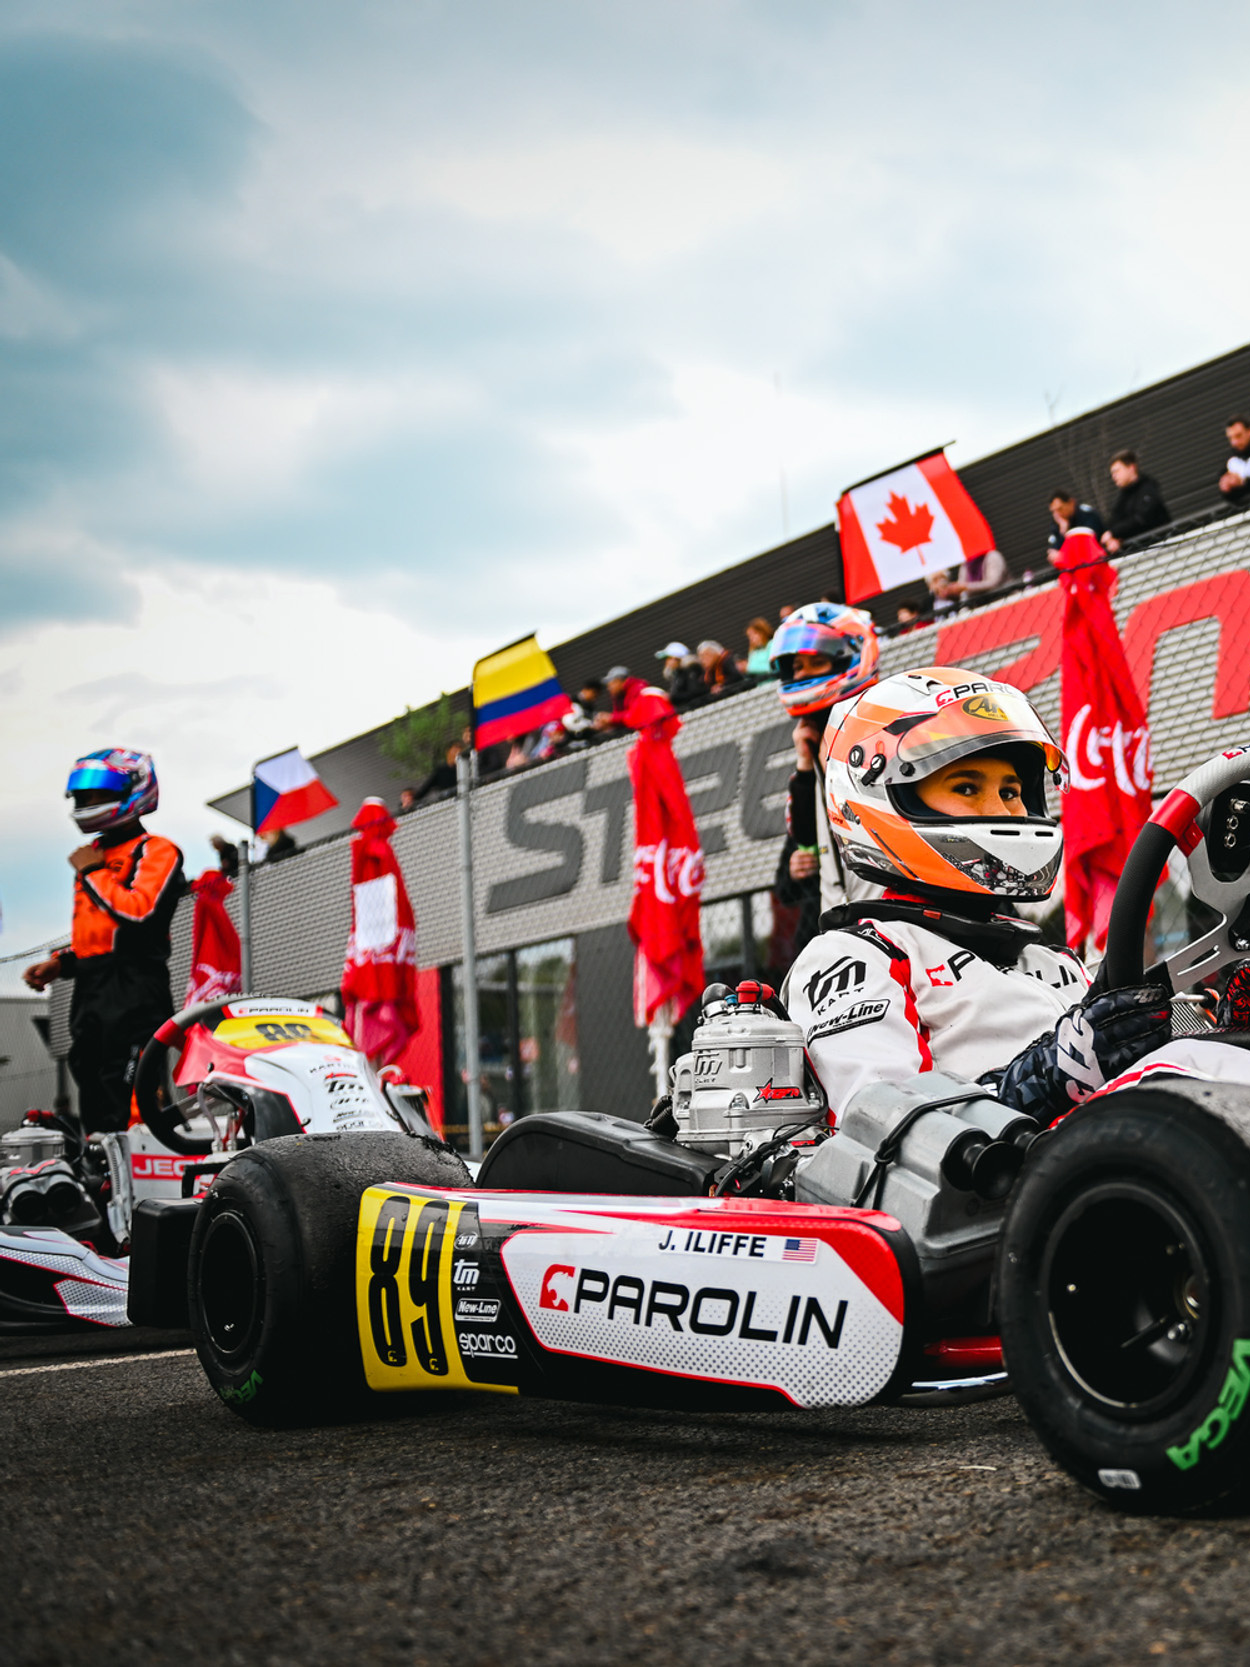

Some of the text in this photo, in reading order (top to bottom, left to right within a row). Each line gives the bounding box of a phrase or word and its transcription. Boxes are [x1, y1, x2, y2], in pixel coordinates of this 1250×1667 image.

[658, 1230, 768, 1258] J. ILIFFE
[368, 1195, 450, 1376] 89
[573, 1268, 849, 1350] PAROLIN
[458, 1332, 517, 1358] sparco
